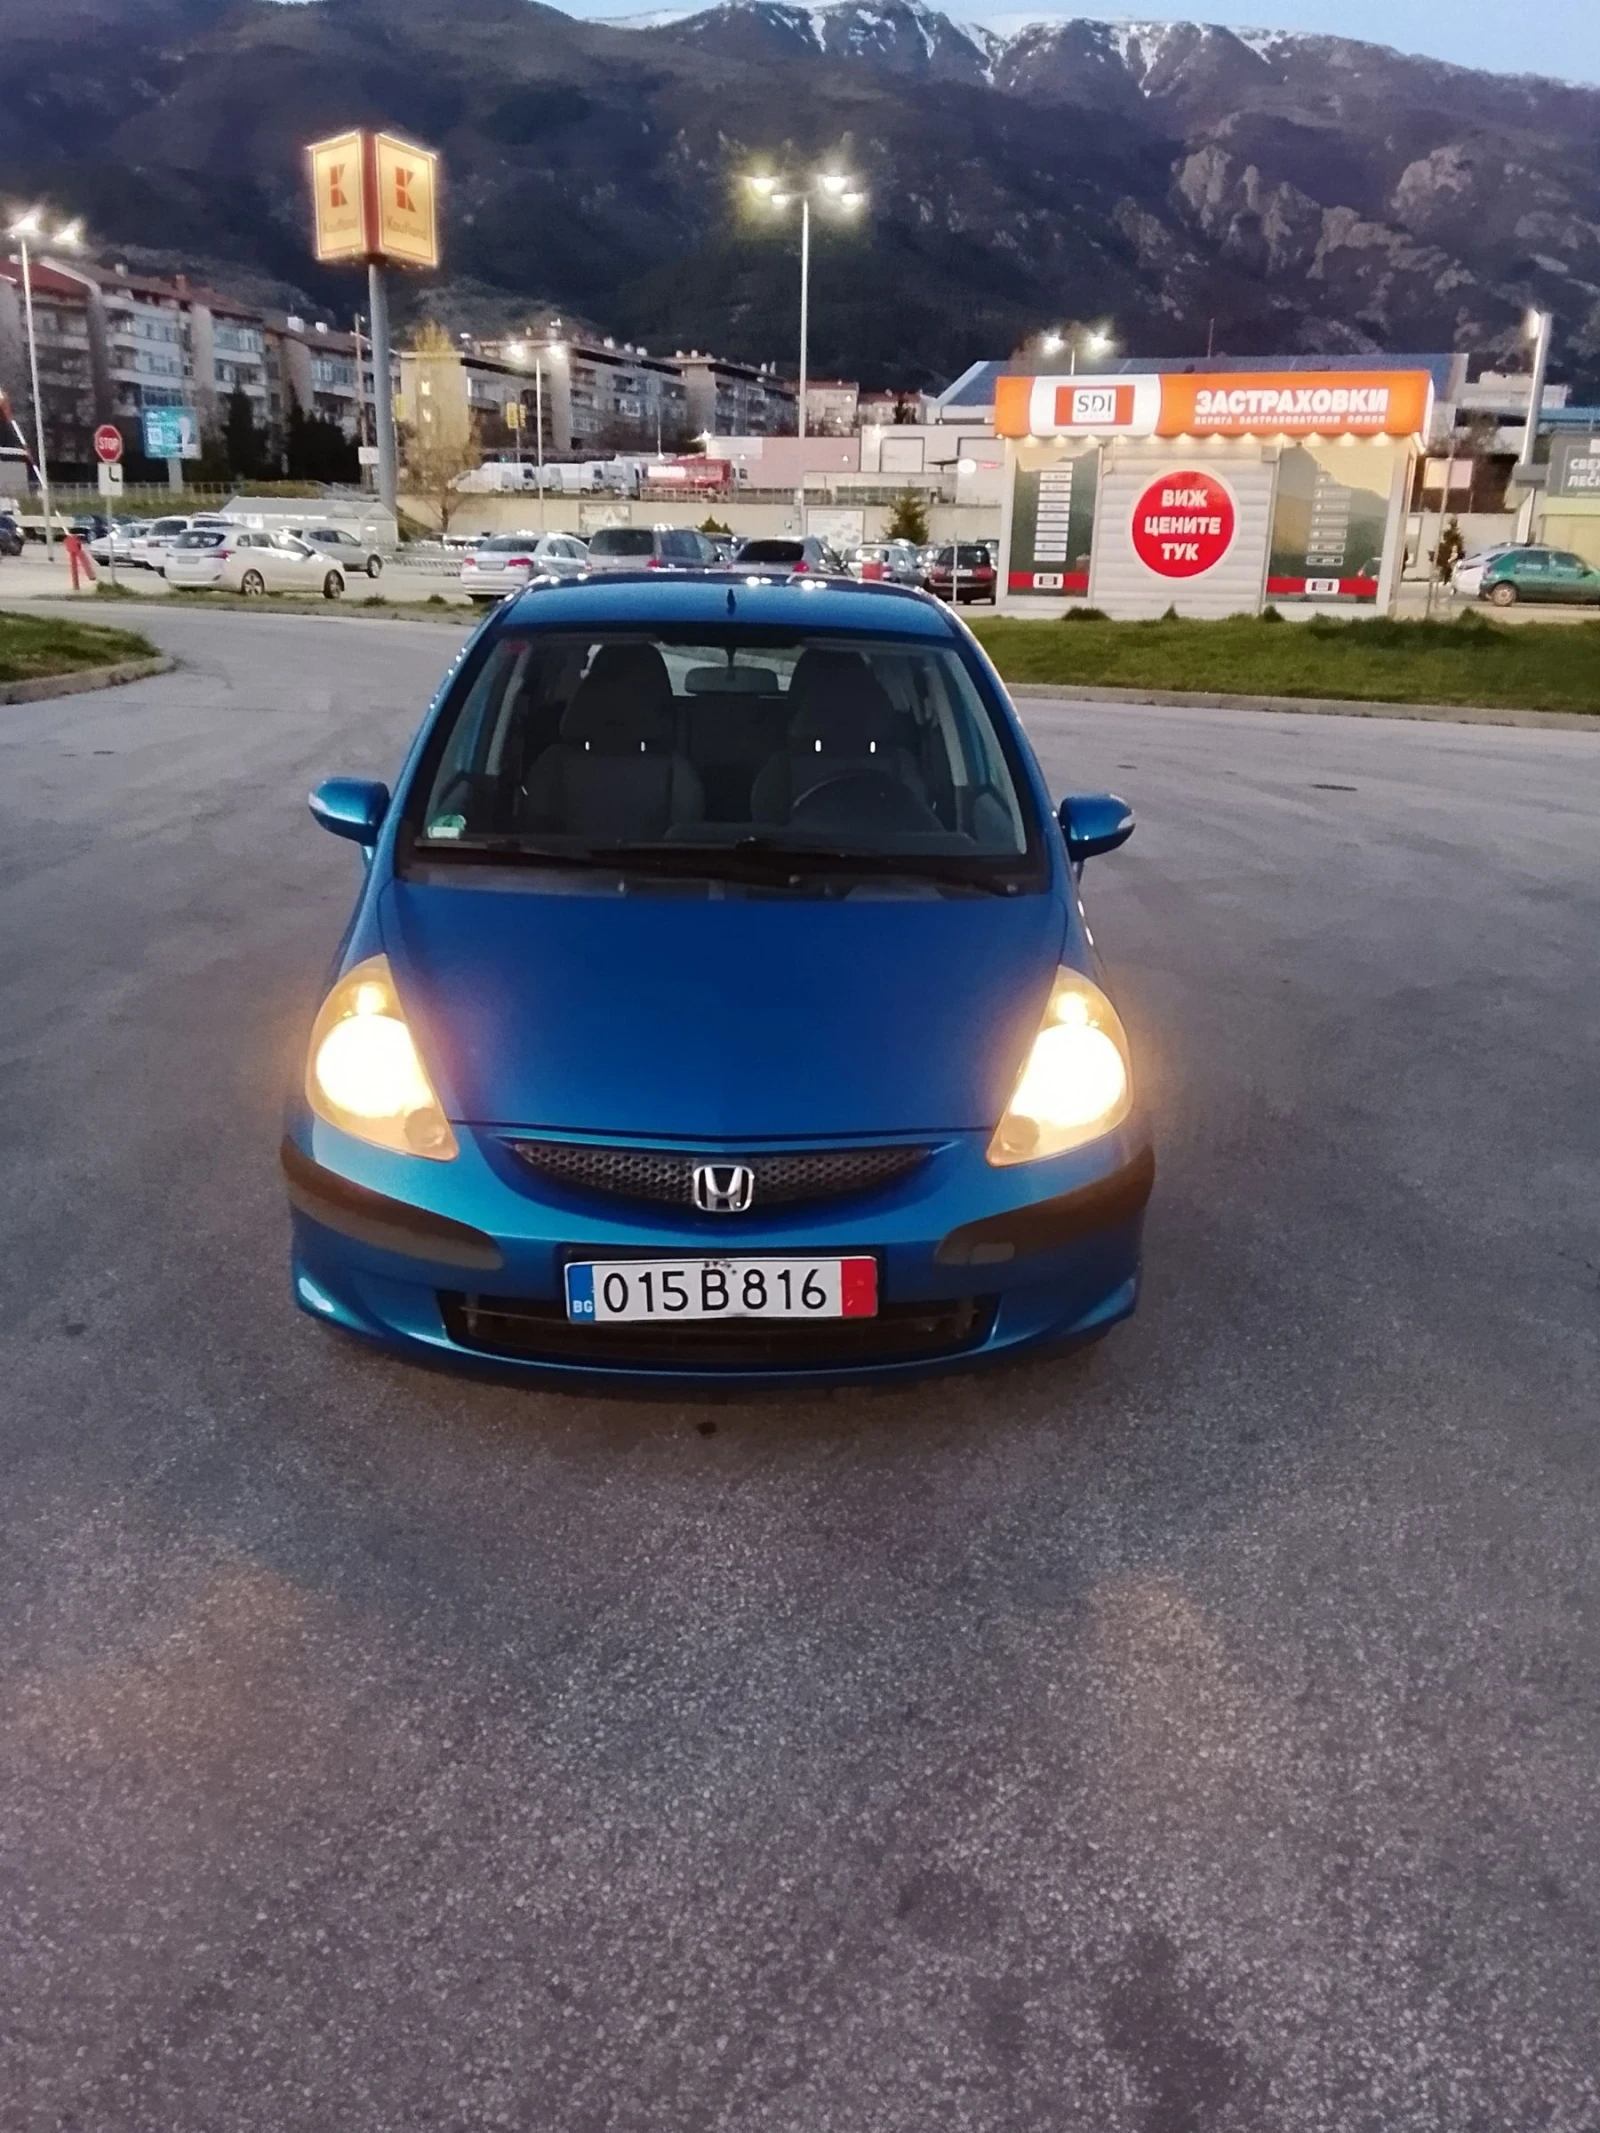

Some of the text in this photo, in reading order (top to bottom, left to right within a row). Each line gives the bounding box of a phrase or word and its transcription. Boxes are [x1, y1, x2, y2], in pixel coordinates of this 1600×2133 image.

[395, 166, 417, 212] K
[1077, 394, 1112, 413] SDI
[1195, 388, 1389, 414] ЗАСТРАХОВКИ
[99, 437, 119, 450] STOP
[1161, 489, 1208, 507] ВИЖ
[1144, 516, 1221, 537] ЦЕНИТЕ
[1161, 542, 1199, 560] ТУК
[573, 1300, 593, 1313] BG
